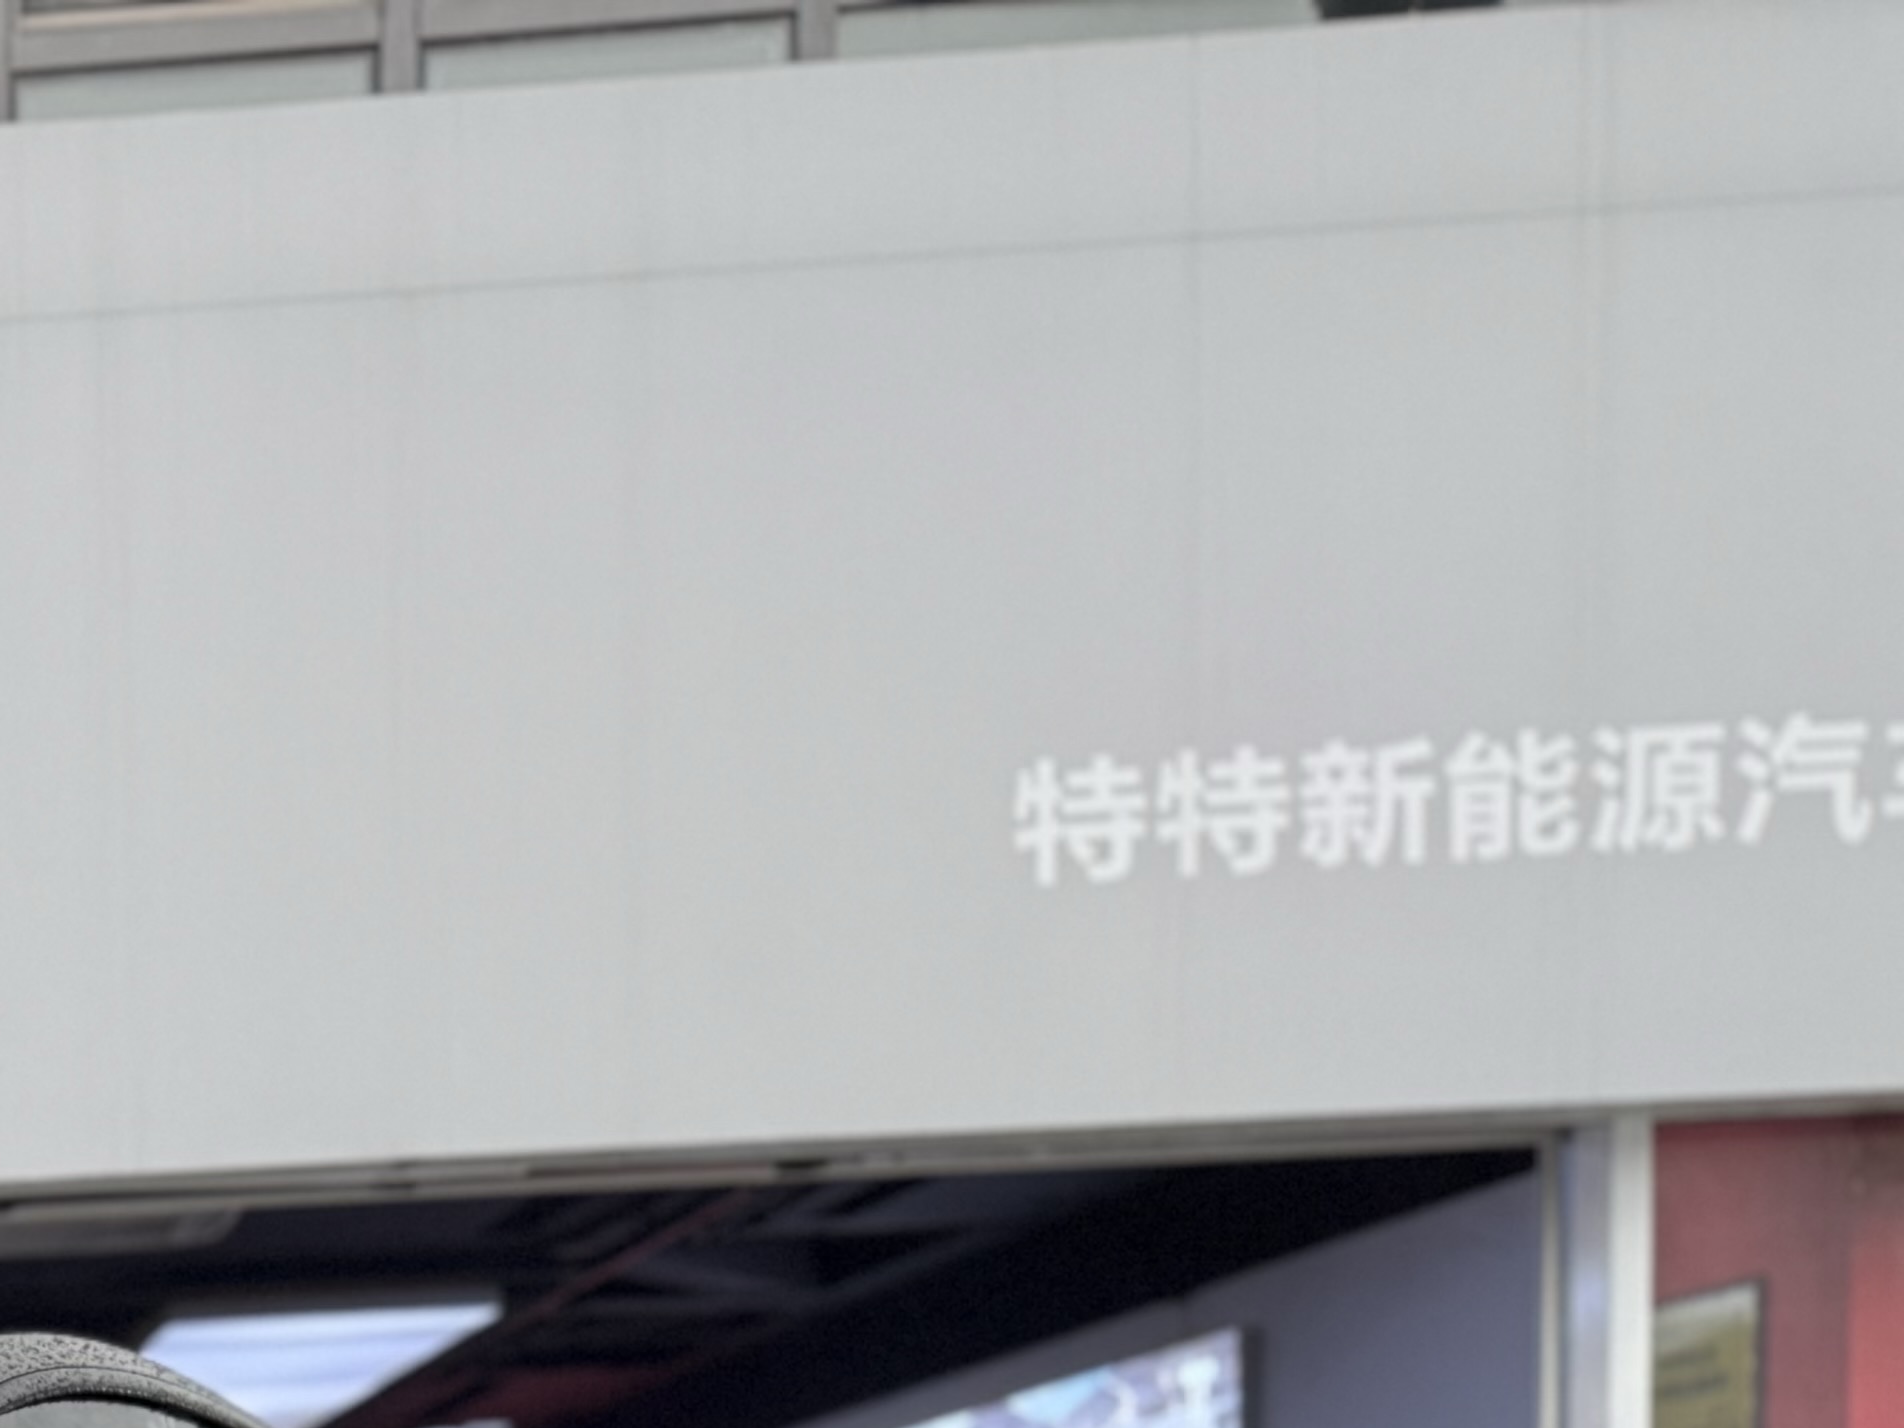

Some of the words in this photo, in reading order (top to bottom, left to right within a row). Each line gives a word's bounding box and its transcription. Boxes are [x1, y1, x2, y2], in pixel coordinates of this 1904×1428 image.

[1012, 712, 1904, 886] 特特新能源汽
